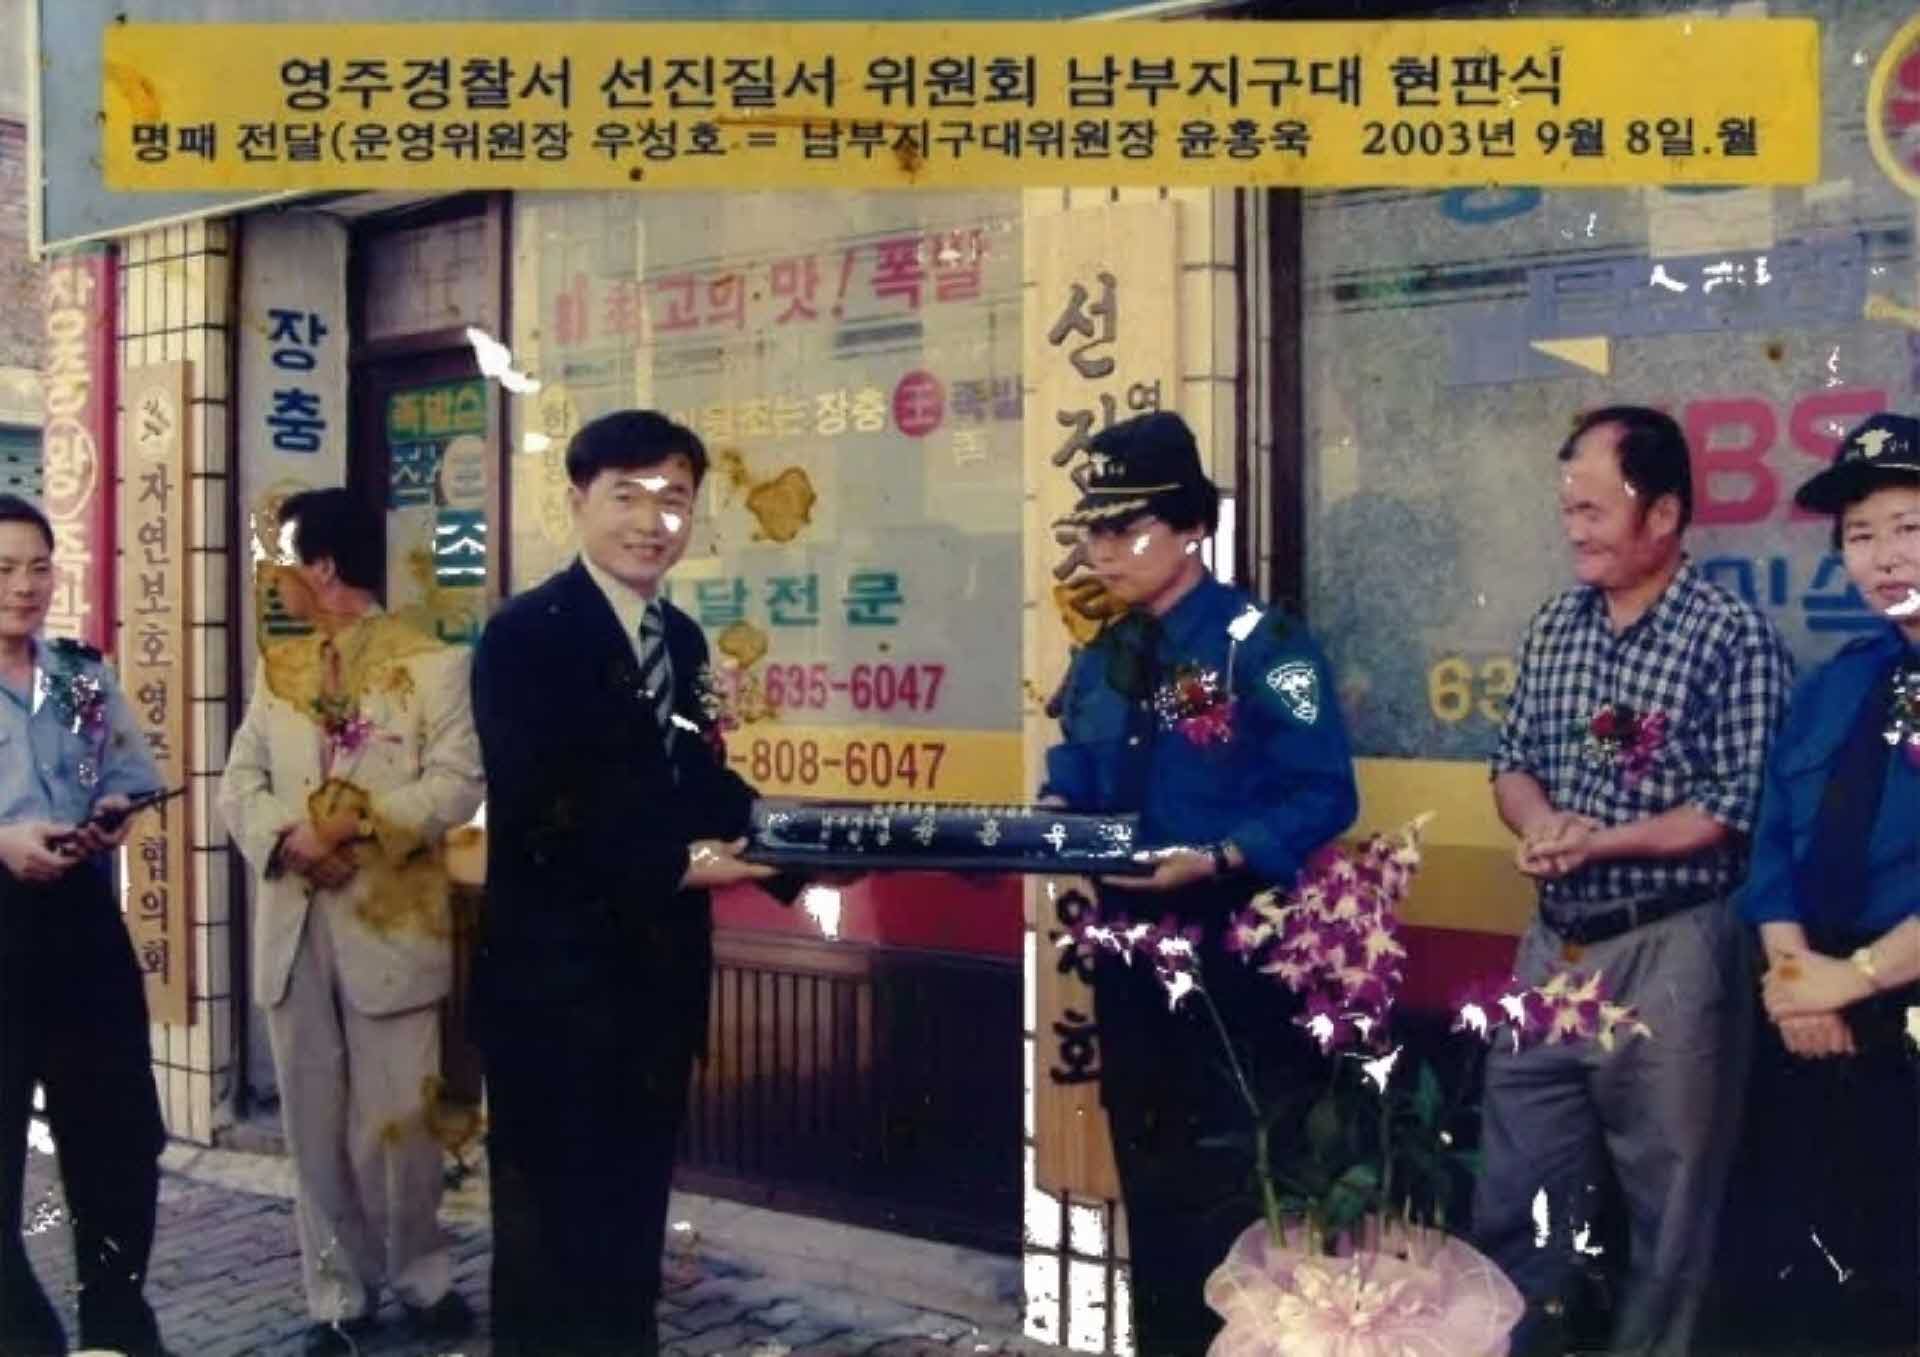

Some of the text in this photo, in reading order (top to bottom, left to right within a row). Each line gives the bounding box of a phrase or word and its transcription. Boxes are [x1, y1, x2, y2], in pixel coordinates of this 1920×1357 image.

[768, 250, 855, 325] 맛!
[1656, 388, 1890, 526] BS
[662, 573, 904, 627] 달전문
